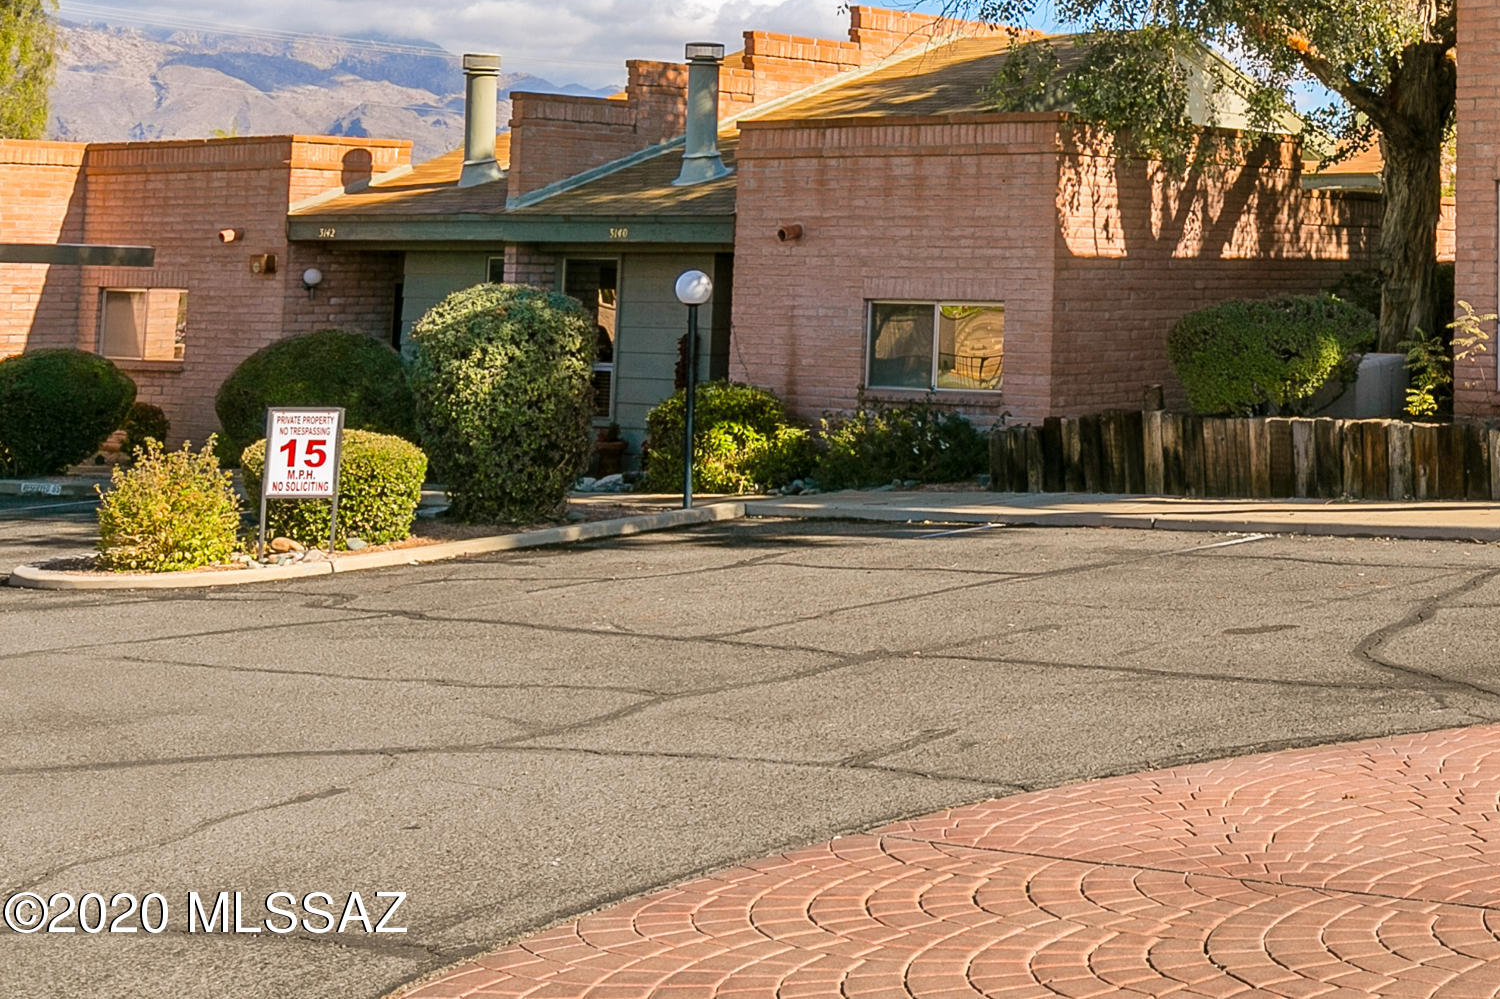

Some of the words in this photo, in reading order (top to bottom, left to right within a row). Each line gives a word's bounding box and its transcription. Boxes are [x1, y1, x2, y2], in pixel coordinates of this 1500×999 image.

[276, 415, 301, 425] PRIVATE
[302, 415, 334, 425] PROPERTY
[279, 427, 289, 435] NO
[290, 427, 331, 436] TRESPASSING
[280, 439, 327, 468] 15
[287, 469, 316, 480] M.P.H.
[272, 481, 284, 491] NO
[285, 481, 329, 492] SOLICITING
